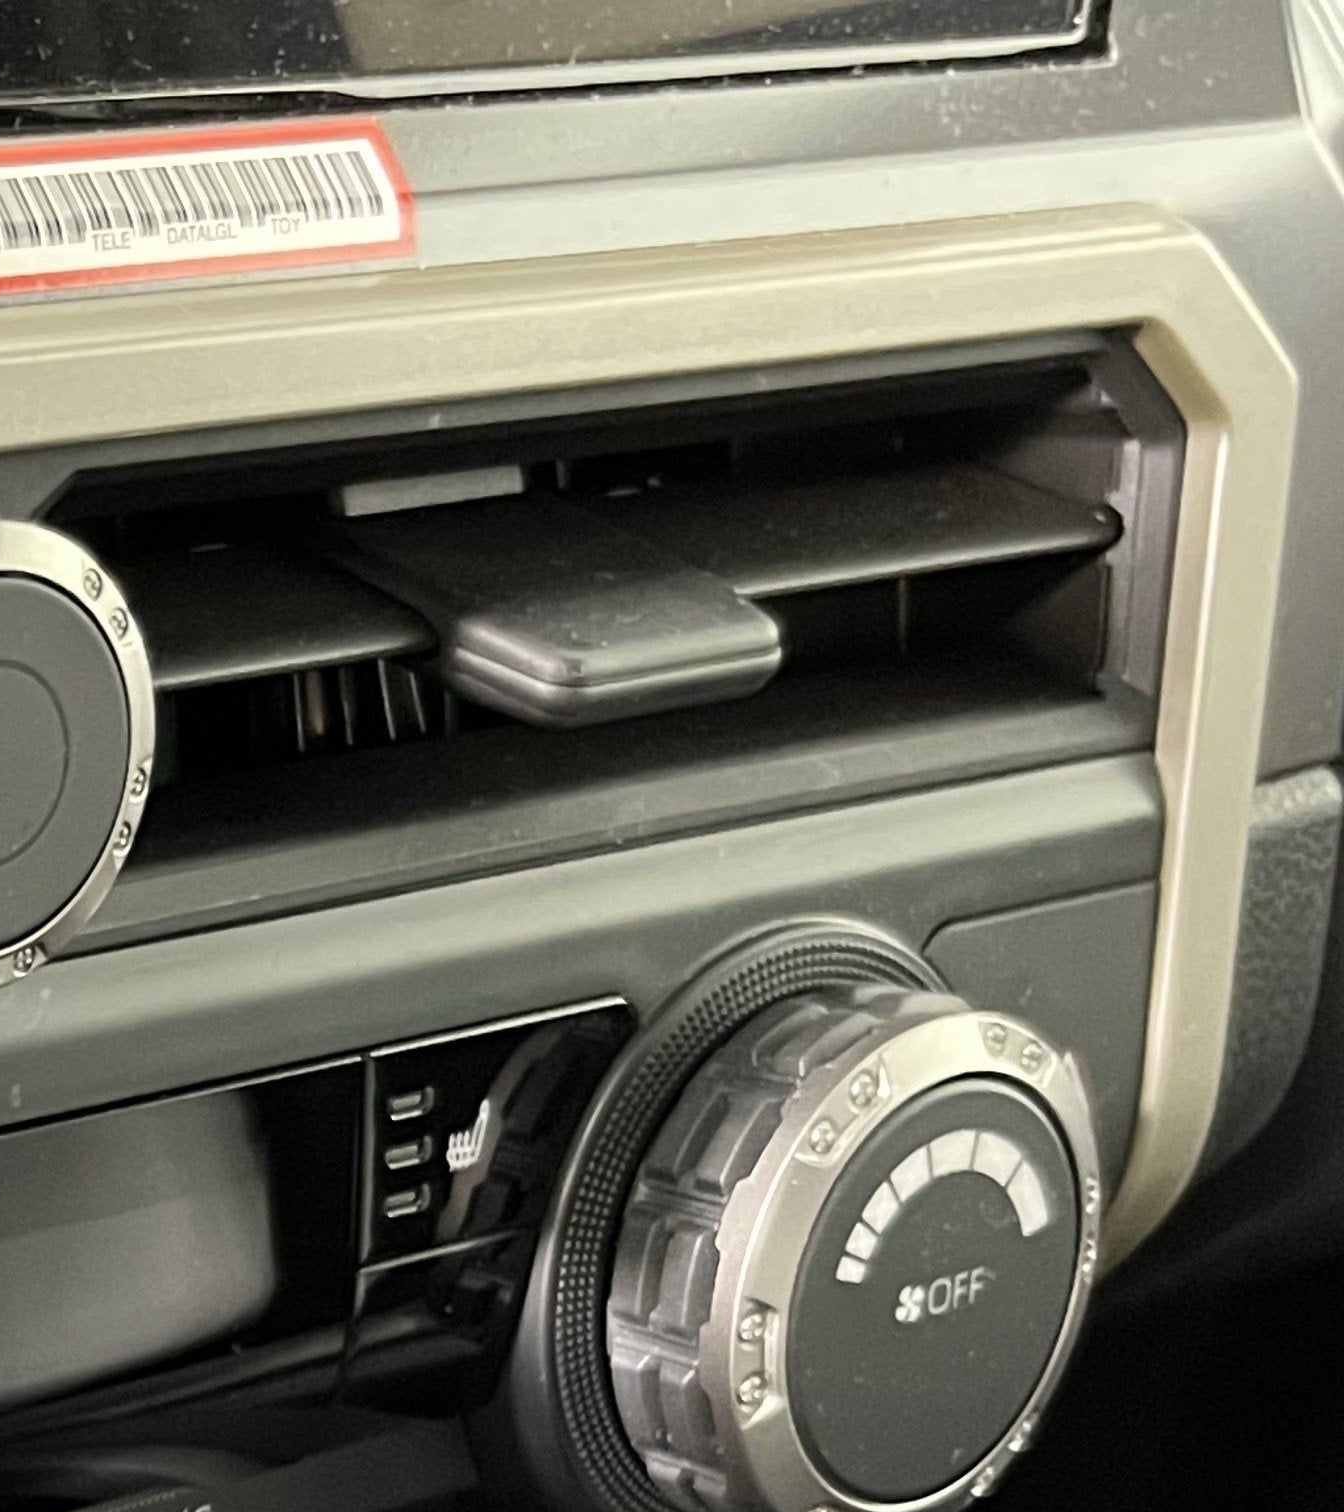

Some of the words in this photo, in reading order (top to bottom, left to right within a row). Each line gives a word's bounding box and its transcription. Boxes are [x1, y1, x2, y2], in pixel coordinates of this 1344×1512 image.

[91, 230, 132, 252] TELE
[270, 216, 301, 235] TOY
[927, 1265, 985, 1315] OFF
